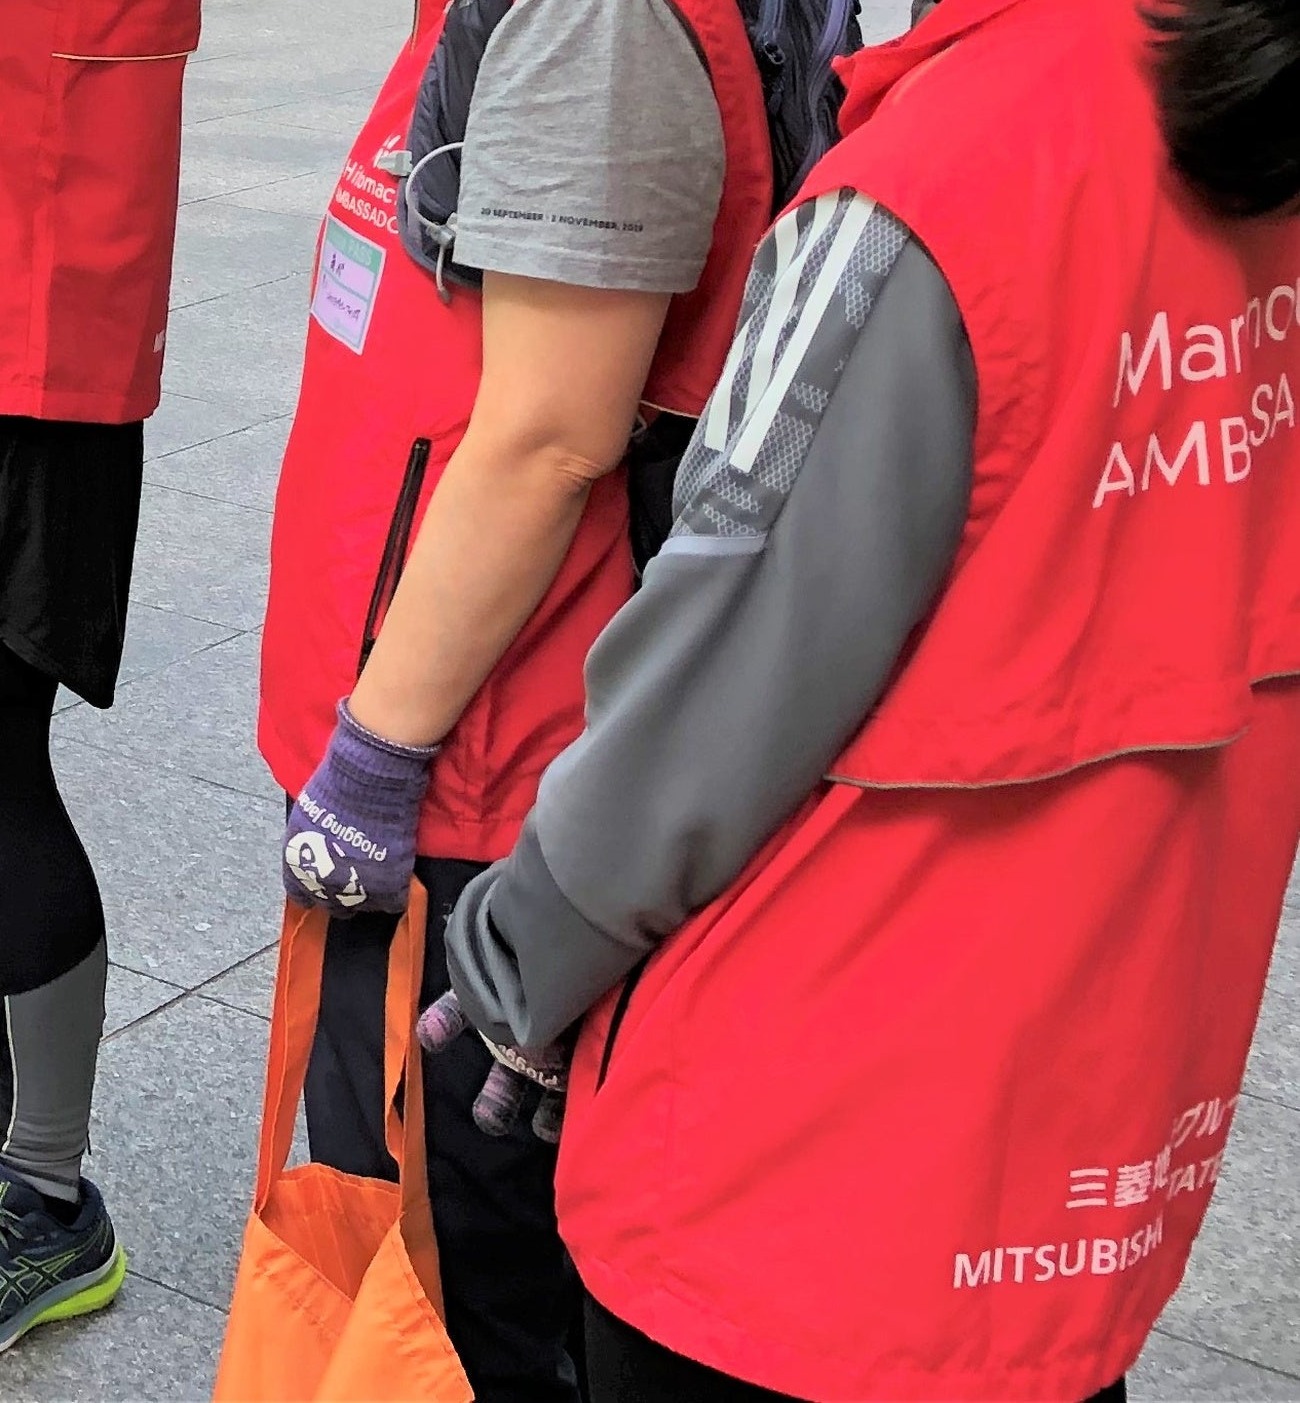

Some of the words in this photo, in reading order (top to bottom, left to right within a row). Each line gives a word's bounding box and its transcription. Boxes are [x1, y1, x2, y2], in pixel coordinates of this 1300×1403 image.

[493, 209, 543, 221] SEPTEMBER
[321, 812, 388, 862] Plogging
[952, 1210, 1164, 1289] MITSUBISHI
